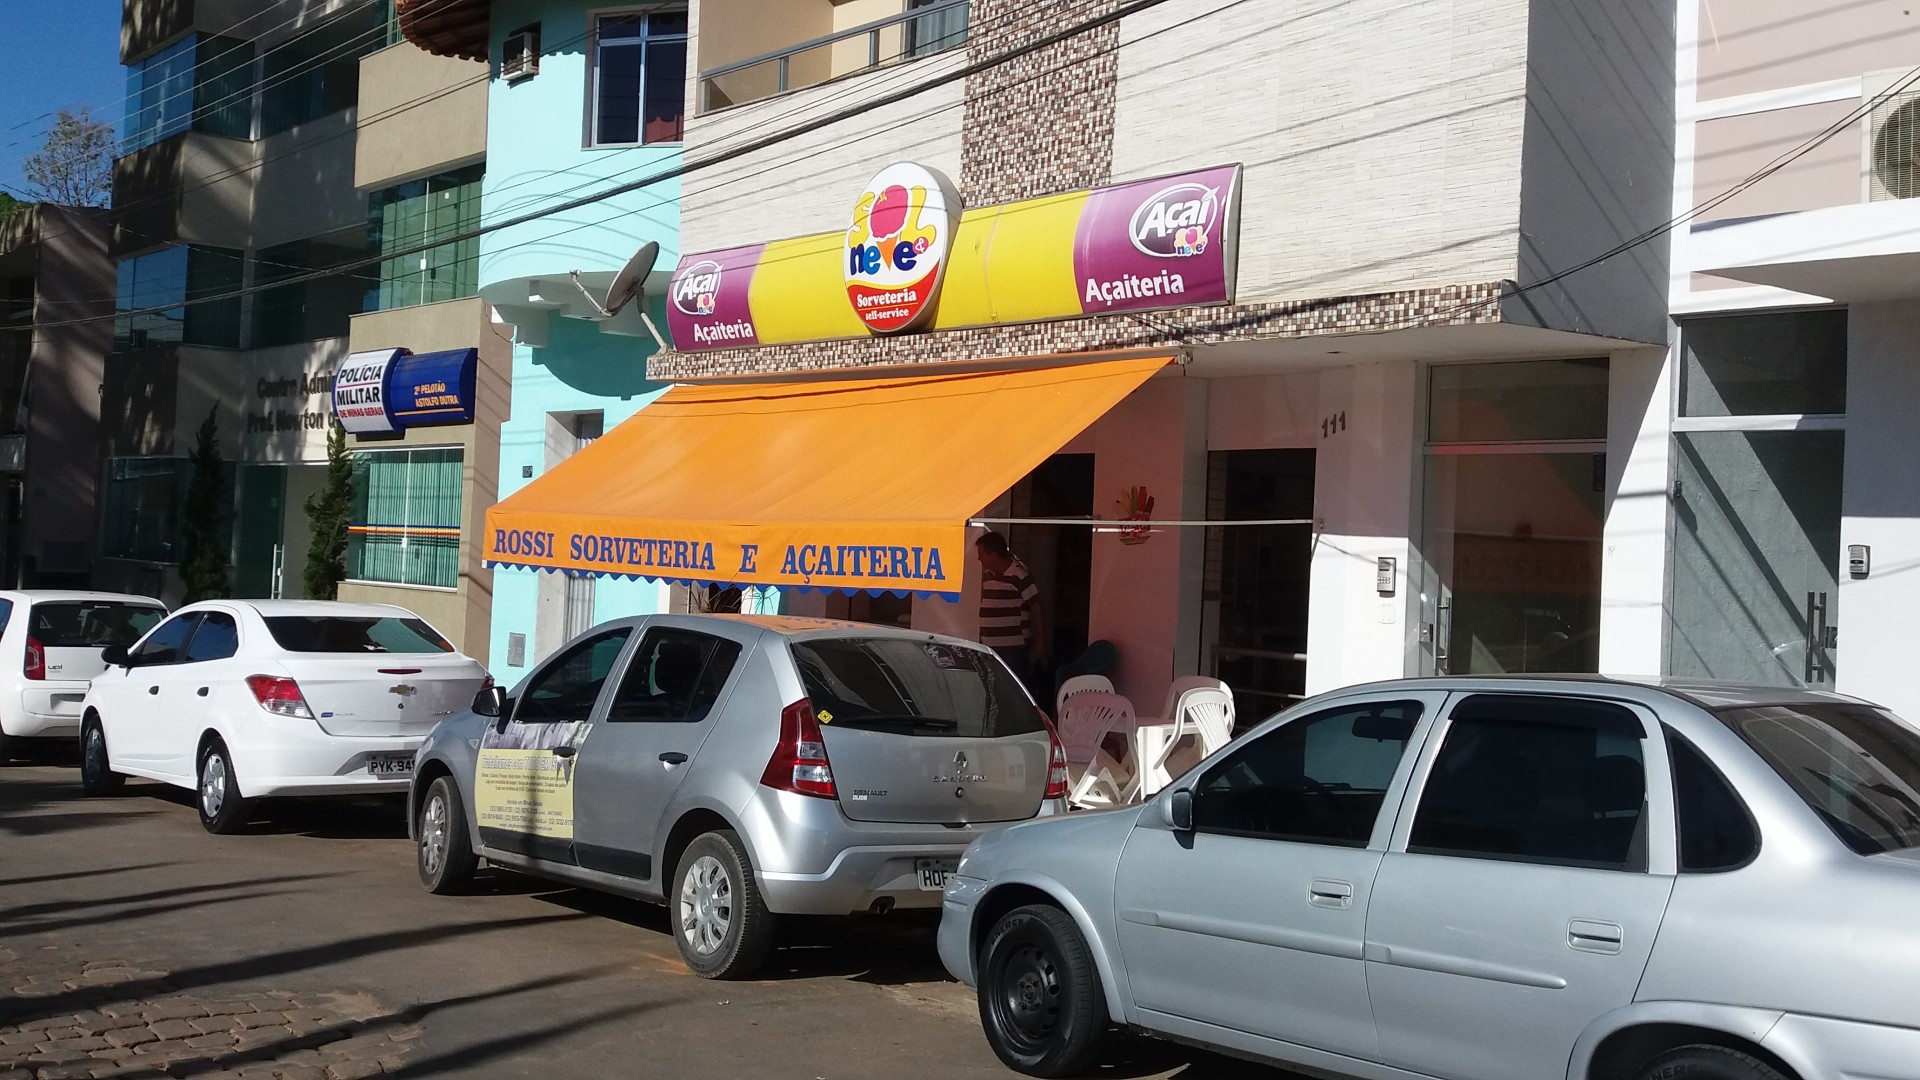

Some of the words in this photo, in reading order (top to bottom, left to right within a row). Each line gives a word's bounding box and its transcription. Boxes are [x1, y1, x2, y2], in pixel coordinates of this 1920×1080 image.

[857, 288, 917, 307] Sorveteria
[1085, 269, 1185, 306] Açaiteria
[865, 308, 909, 321] self-service
[694, 319, 754, 345] Açaiteria
[338, 364, 383, 384] POLÍCIA
[337, 386, 380, 406] MILITAR
[421, 380, 446, 393] PELOTÃO
[415, 397, 439, 407] ASTOLFO
[439, 395, 459, 405] DUTRA
[339, 409, 347, 418] DE
[348, 408, 365, 418] MINAS
[365, 406, 384, 417] GERAIS
[1322, 411, 1346, 439] 111
[493, 529, 554, 558] ROSSI
[570, 533, 715, 570] SORVETERIA
[739, 545, 758, 573] E
[780, 545, 946, 584] AÇAITERIA
